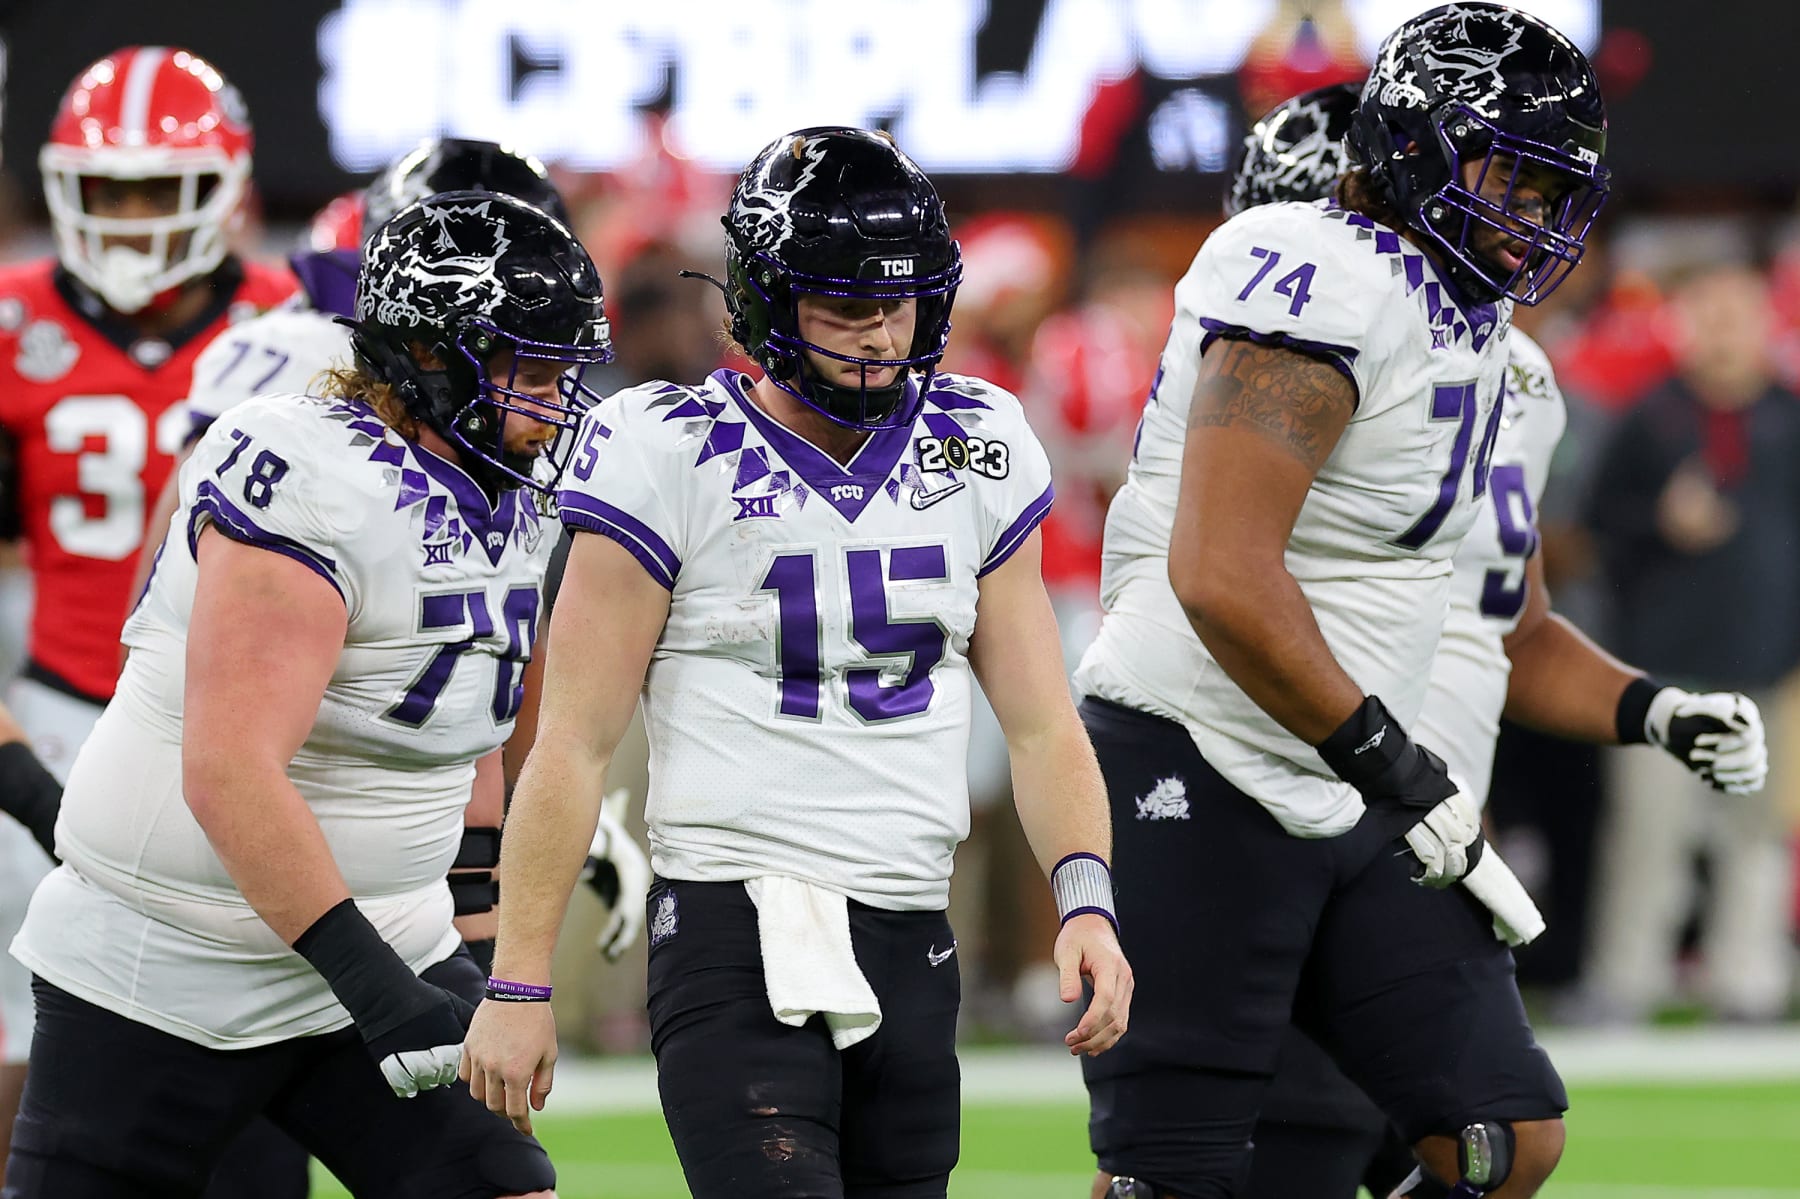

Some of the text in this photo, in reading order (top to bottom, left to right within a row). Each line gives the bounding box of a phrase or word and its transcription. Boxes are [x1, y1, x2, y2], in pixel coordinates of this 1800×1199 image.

[880, 259, 914, 277] TCU
[1236, 246, 1317, 317] 74
[212, 340, 289, 392] 77
[44, 393, 187, 562] 3
[215, 427, 290, 510] 78
[830, 485, 866, 502] TCU
[732, 495, 782, 521] XII
[423, 541, 453, 566] XII
[751, 544, 951, 726] 15
